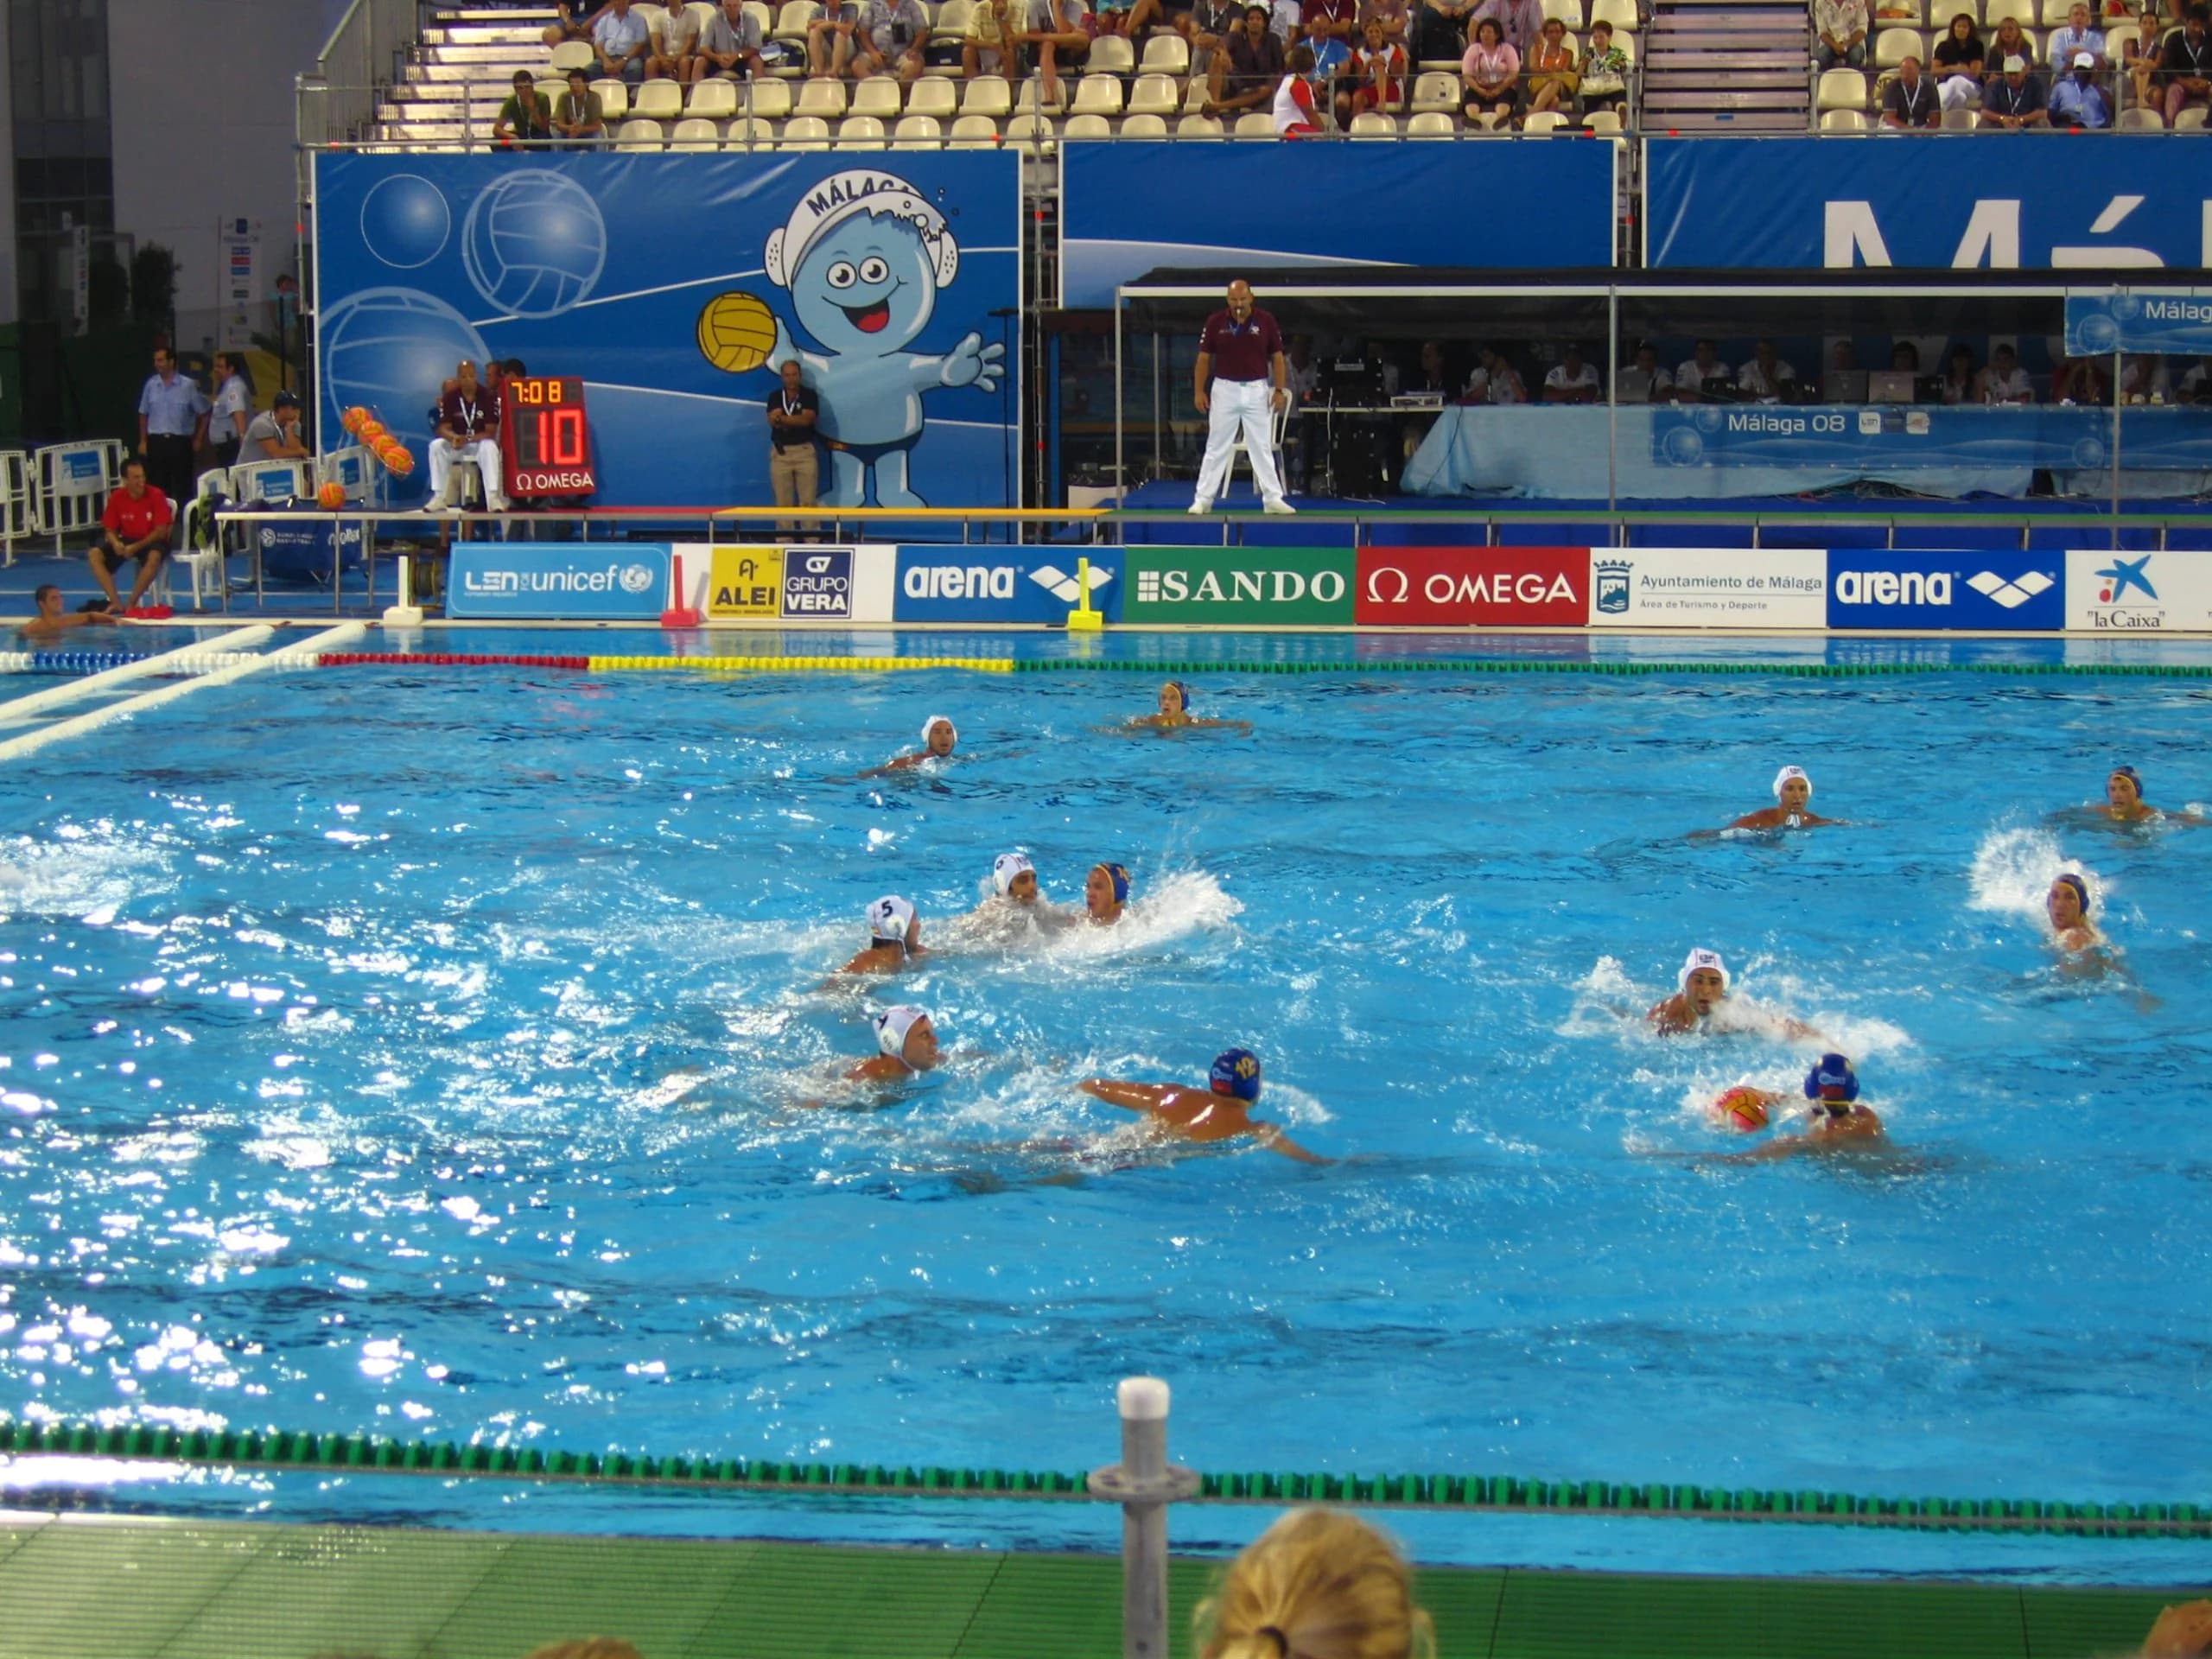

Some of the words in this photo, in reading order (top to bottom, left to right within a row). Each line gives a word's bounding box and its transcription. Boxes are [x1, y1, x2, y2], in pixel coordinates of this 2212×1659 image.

[511, 381, 562, 404] 7:08
[1728, 414, 1805, 435] Málaga
[1812, 415, 1846, 432] 08
[538, 409, 583, 466] 10
[535, 472, 594, 490] OMEGA
[531, 564, 618, 592] unicef
[786, 576, 848, 592] GRUPO
[904, 566, 1014, 599] arena
[1161, 570, 1346, 602] SANDO
[1424, 572, 1578, 603] OMEGA
[1640, 575, 1742, 590] Ayuntamiento
[1746, 576, 1764, 588] de
[1769, 575, 1822, 592] Málaga
[1835, 571, 1952, 606] arena
[715, 587, 776, 606] ALEI
[786, 594, 847, 611] VERA
[1666, 600, 1678, 609] de
[1680, 601, 1719, 609] Turismo
[1721, 602, 1726, 611] y
[1728, 601, 1768, 611] Deporte
[881, 899, 893, 918] 5
